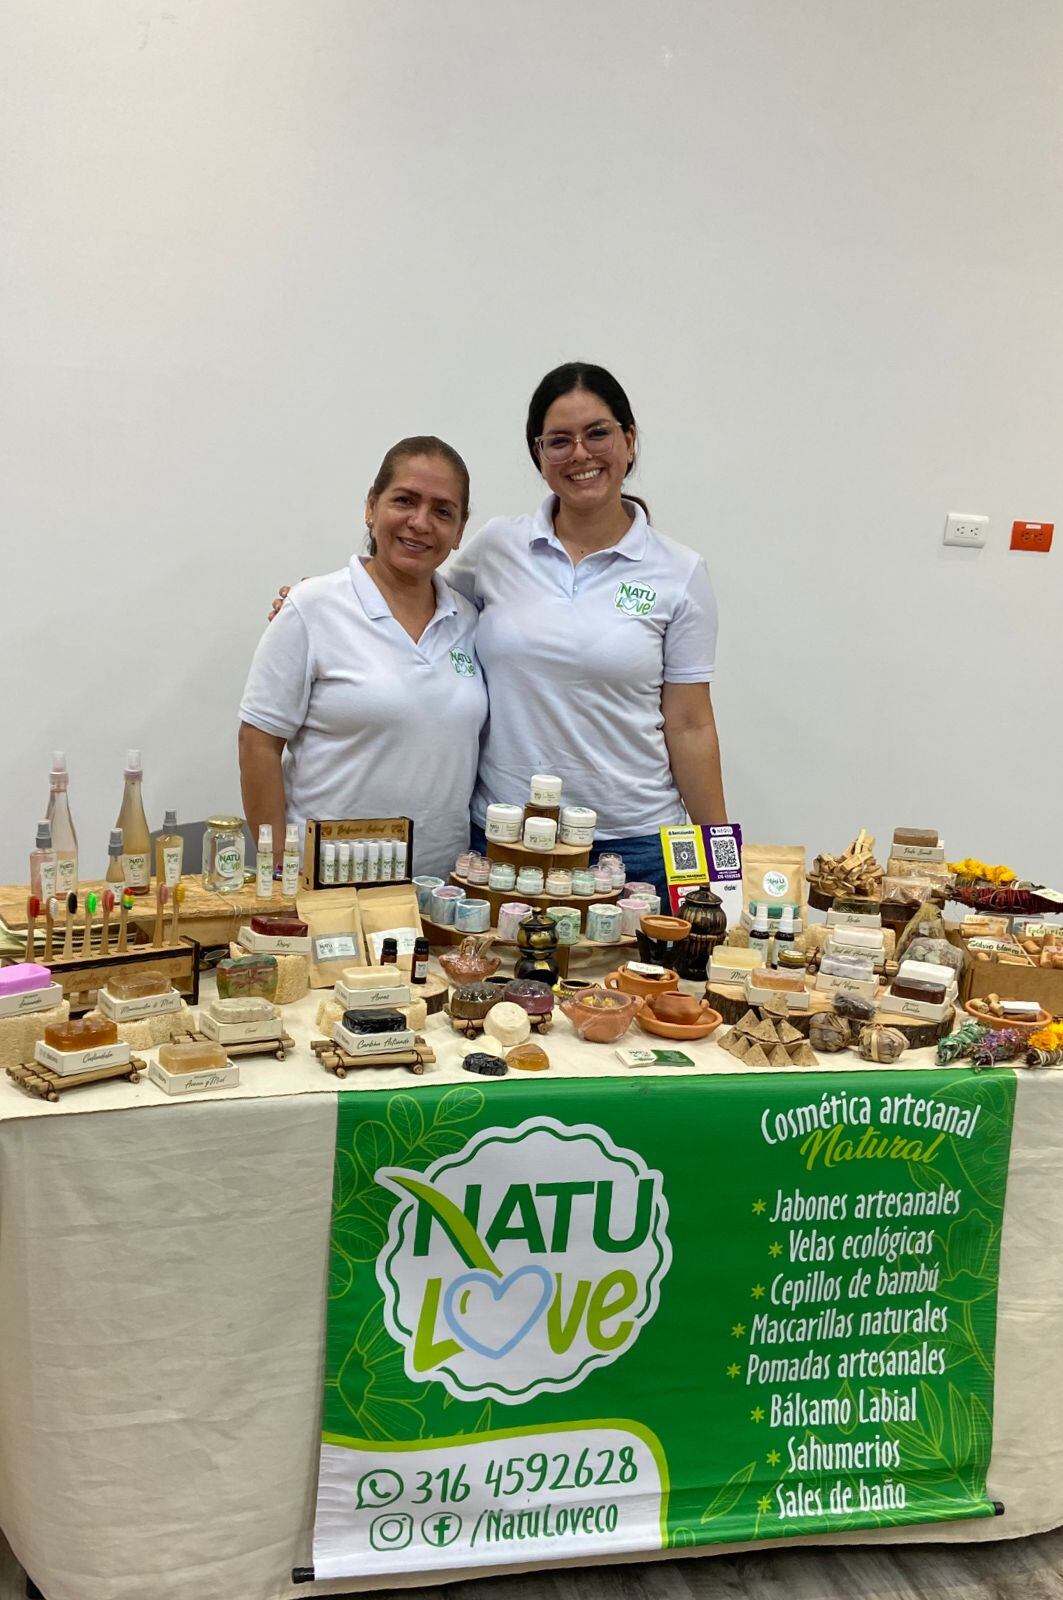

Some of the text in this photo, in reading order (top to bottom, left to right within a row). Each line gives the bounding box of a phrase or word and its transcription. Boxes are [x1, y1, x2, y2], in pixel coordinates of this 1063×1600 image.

[619, 582, 657, 602] NATU
[449, 648, 473, 664] NATU
[219, 853, 241, 863] NATU
[760, 1090, 982, 1146] Cosmética artesanal
[800, 1122, 946, 1170] Natural
[769, 1182, 962, 1223] Jabones artesanales
[385, 1175, 655, 1278] NATU
[788, 1224, 936, 1264] Velas ecológicas
[770, 1261, 940, 1312] Cepillos de bambú
[748, 1299, 948, 1346] Mascarillas naturales
[745, 1341, 947, 1386] Pomadas artesanales
[769, 1386, 918, 1429] Bálsamo Labial
[411, 1445, 639, 1505] 316 4592628
[787, 1434, 901, 1474] Sahumerios
[775, 1478, 907, 1520] Sales de baño
[470, 1503, 619, 1548] /NatuLoveco
